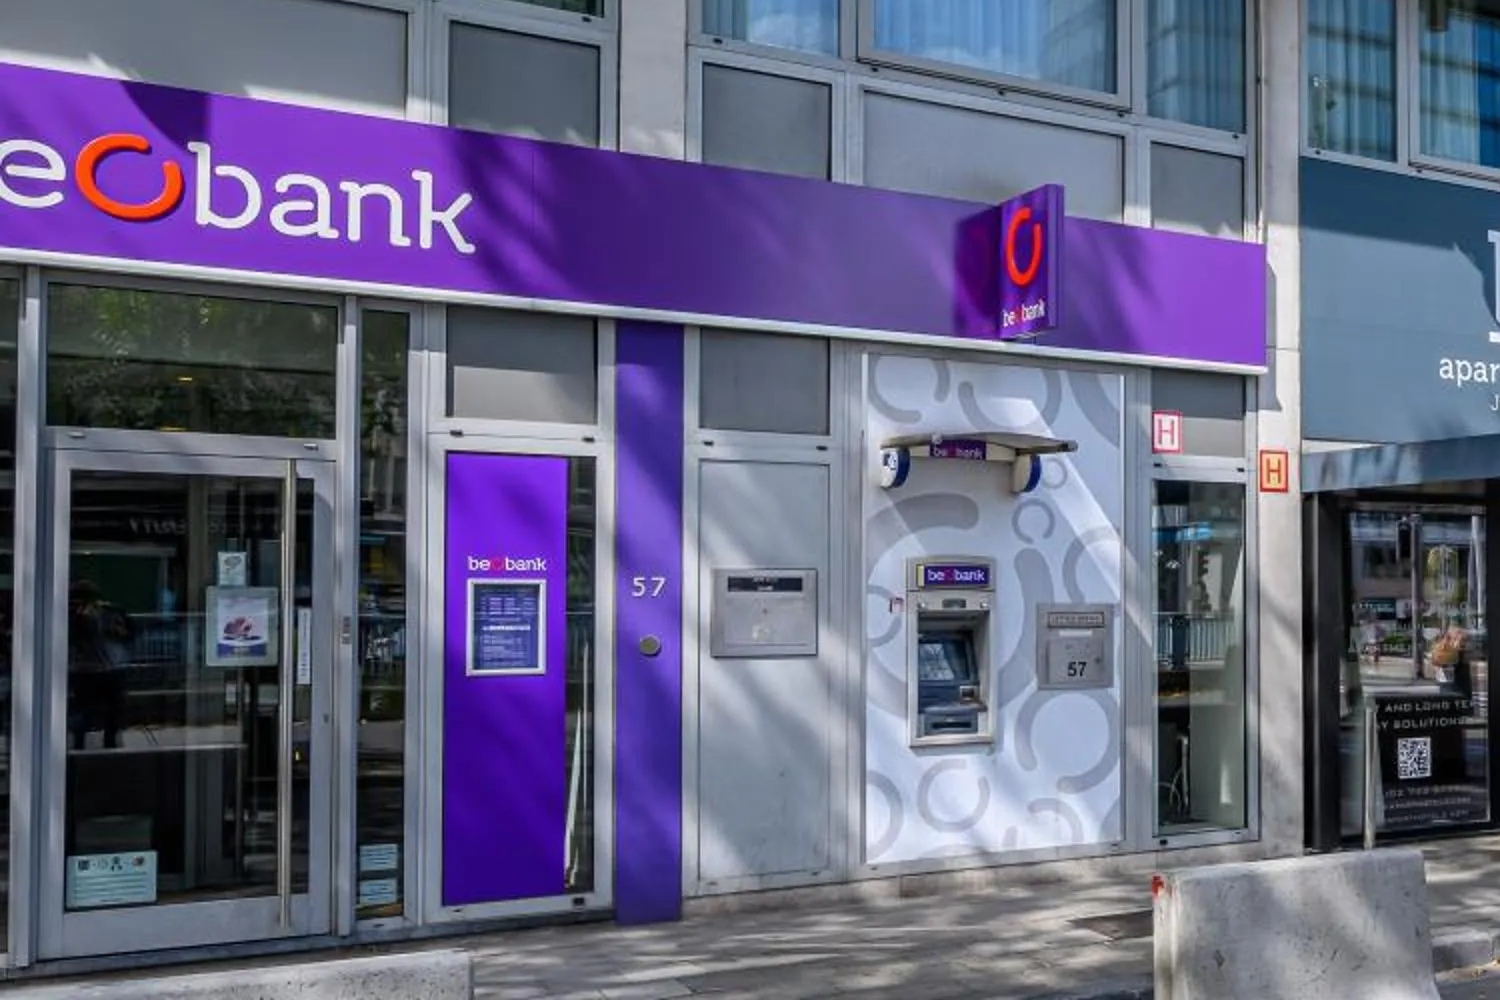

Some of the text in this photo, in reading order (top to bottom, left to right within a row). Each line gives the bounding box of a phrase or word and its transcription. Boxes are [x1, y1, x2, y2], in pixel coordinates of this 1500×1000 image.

[1158, 418, 1175, 446] H
[1266, 457, 1282, 485] H
[632, 577, 666, 597] 57
[1067, 661, 1087, 677] 57
